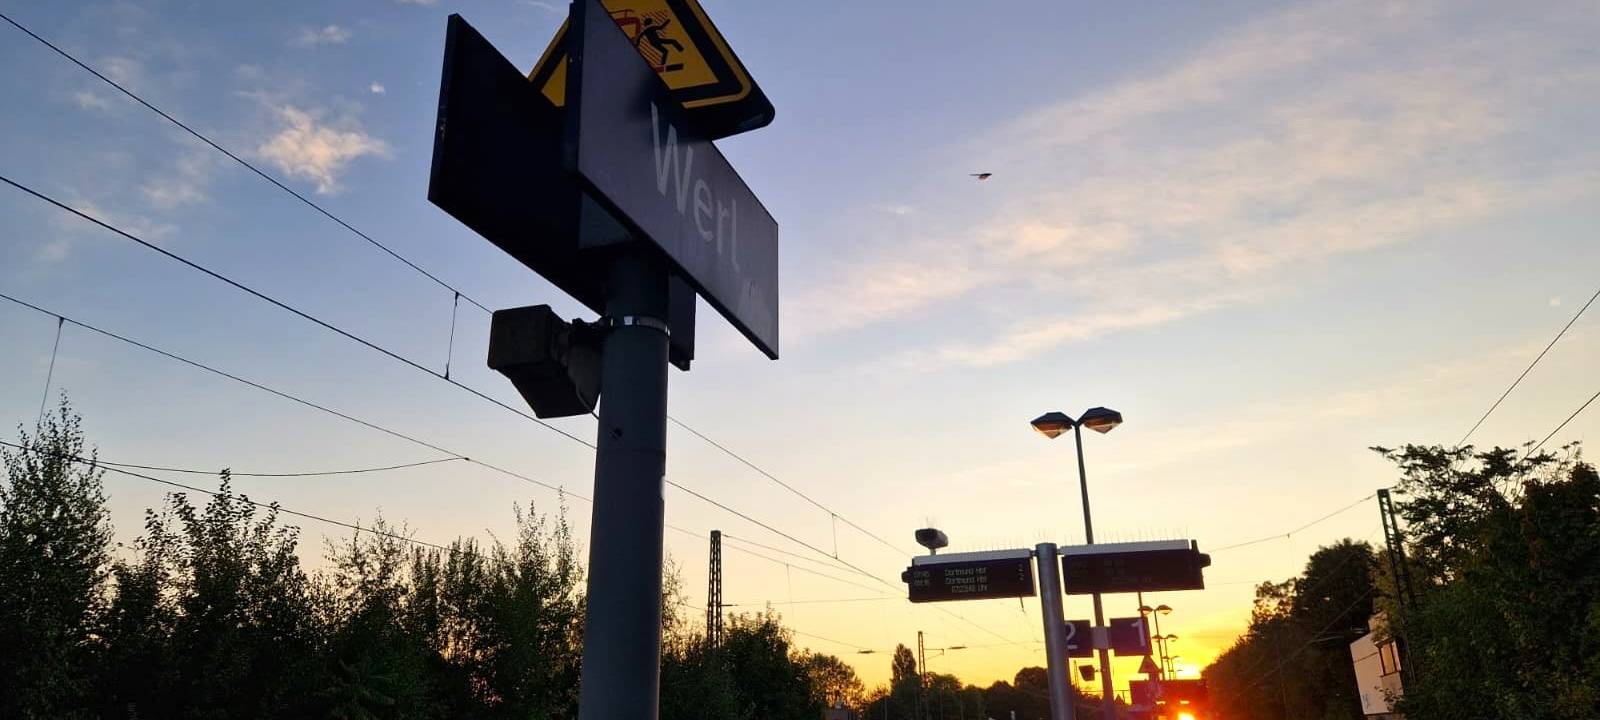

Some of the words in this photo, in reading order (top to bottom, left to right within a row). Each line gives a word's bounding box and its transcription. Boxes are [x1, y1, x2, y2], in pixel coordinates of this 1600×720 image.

[650, 101, 740, 274] Werl
[944, 568, 974, 577] Dortmund
[944, 577, 975, 585] Dortmund
[1065, 622, 1078, 650] 2
[1131, 618, 1146, 647] 1
